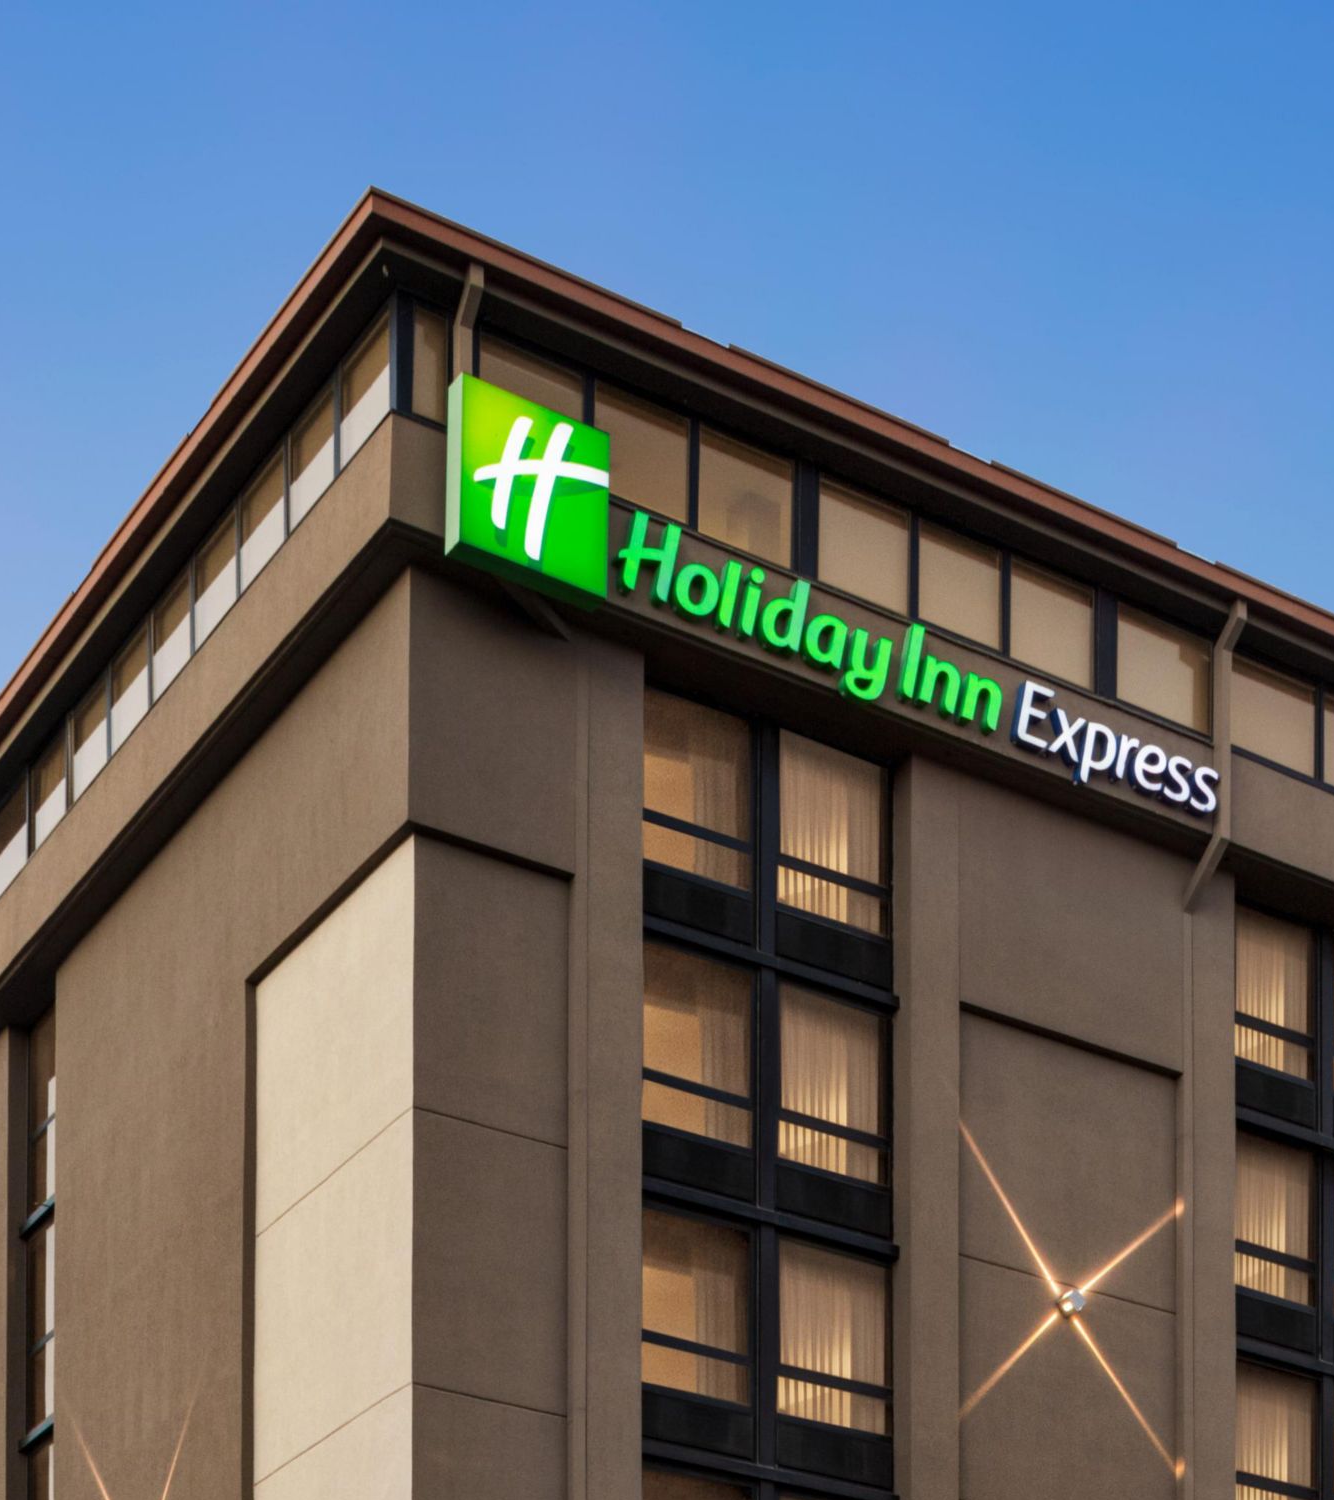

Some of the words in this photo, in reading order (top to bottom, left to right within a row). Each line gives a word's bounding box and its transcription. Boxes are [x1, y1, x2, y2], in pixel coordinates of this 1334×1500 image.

[473, 416, 610, 561] H
[616, 510, 893, 700] Holiday
[898, 623, 1003, 734] Inn
[1014, 680, 1220, 814] Express
